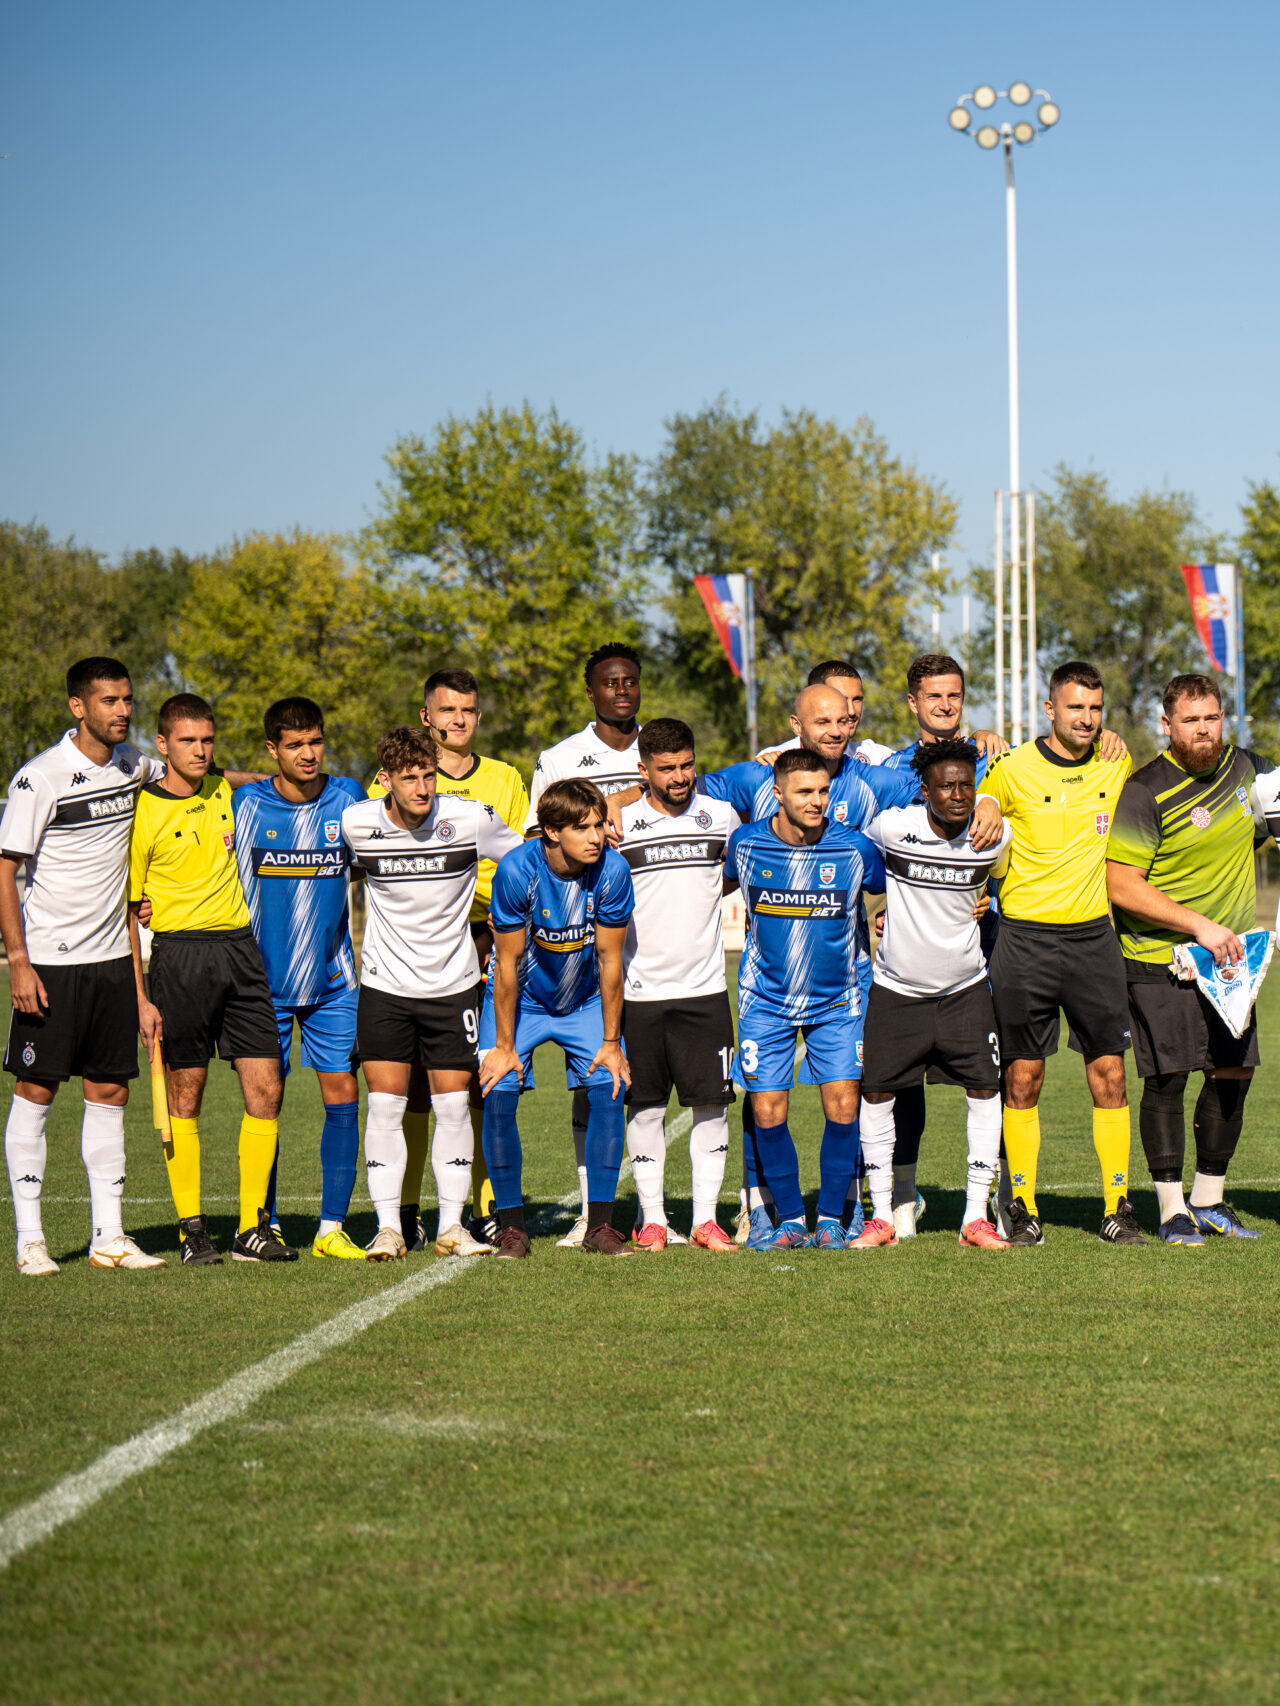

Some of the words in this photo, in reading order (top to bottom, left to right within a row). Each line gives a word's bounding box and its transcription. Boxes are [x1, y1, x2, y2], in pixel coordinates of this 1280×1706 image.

[87, 792, 135, 819] MAXBET
[261, 851, 344, 866] ADMIRAL
[645, 843, 708, 863] MAXBET
[317, 864, 344, 877] BET
[378, 855, 447, 874] MAXBET
[908, 863, 976, 884] MAXBET
[758, 890, 842, 906] ADMIRAL
[811, 907, 841, 917] BET
[741, 1039, 759, 1073] 3
